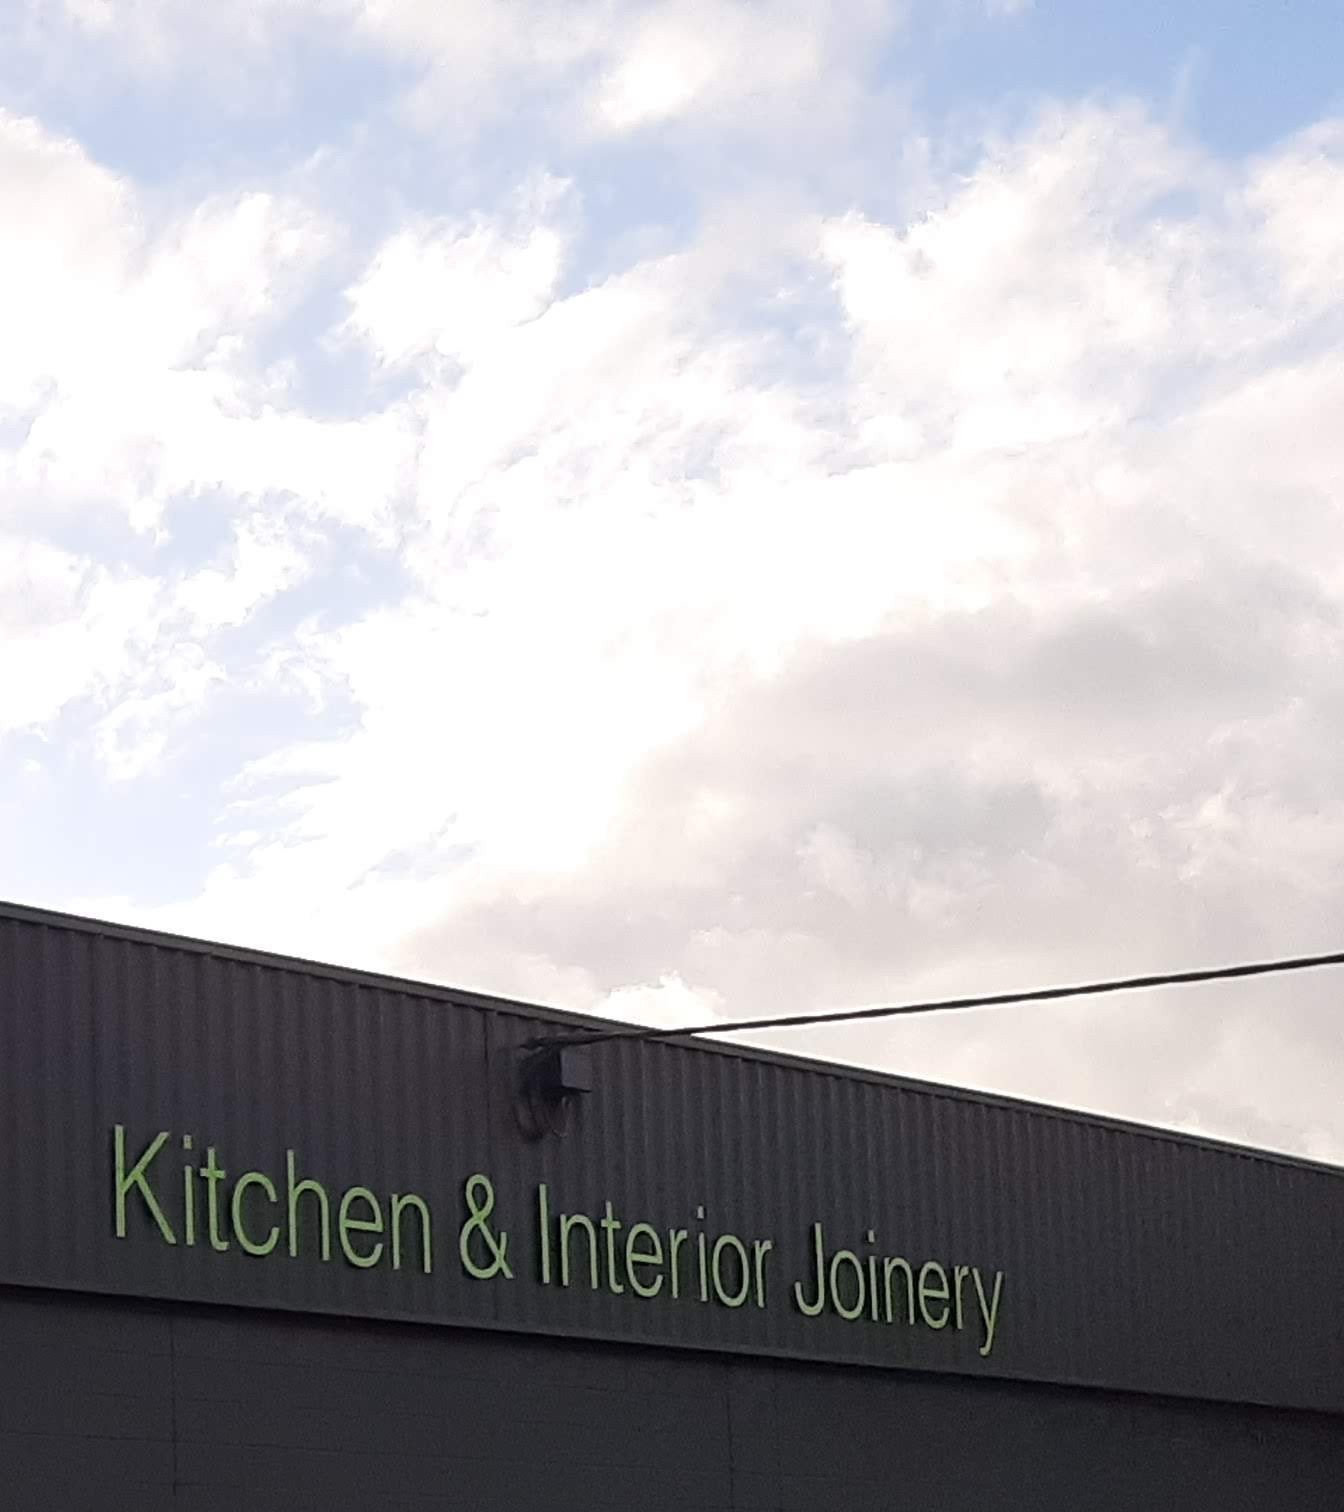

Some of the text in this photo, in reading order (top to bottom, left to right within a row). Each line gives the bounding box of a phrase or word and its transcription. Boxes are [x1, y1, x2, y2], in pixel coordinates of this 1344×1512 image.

[114, 1124, 1004, 1356] Kitchen & Interior Joinery
